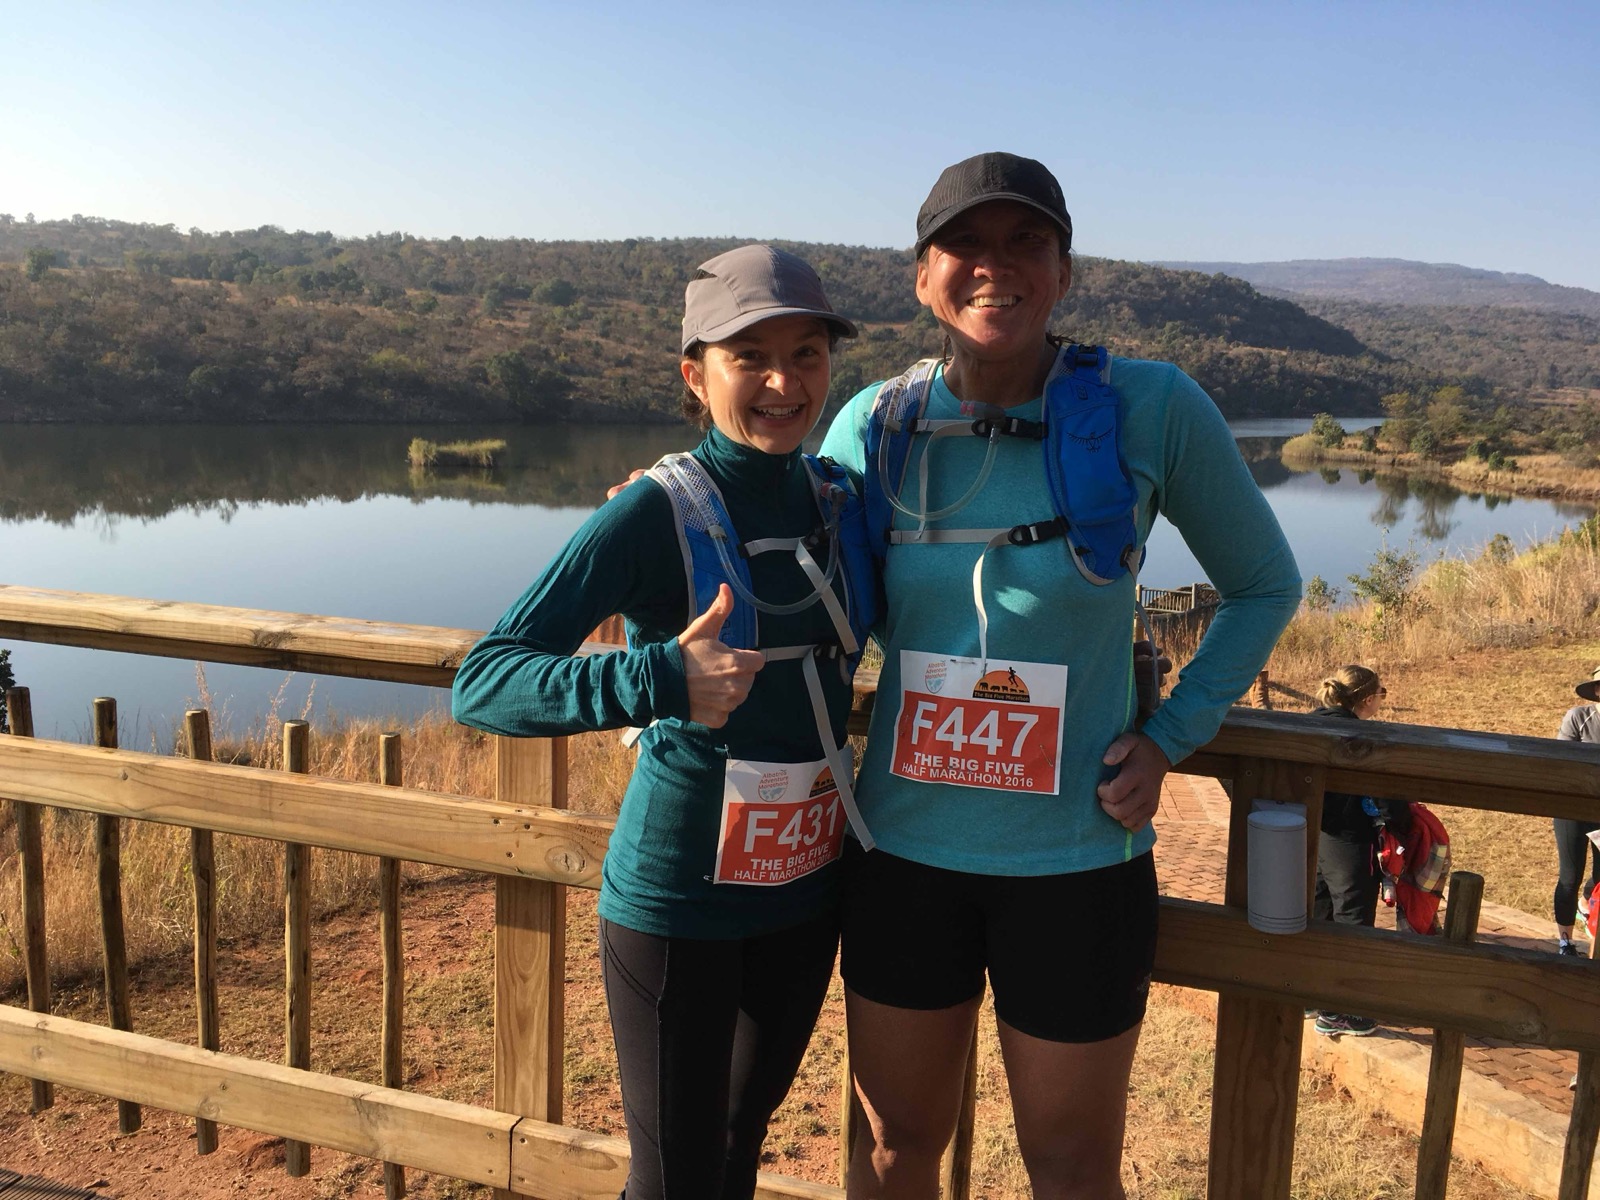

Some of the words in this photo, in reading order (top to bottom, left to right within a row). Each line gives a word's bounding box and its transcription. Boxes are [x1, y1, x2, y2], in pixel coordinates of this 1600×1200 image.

[1005, 694, 1029, 702] Marathon
[911, 700, 1039, 758] F447
[902, 762, 926, 777] HALF
[929, 769, 1002, 785] MARATHON
[1005, 776, 1034, 788] 2016
[914, 752, 943, 768] THE
[949, 756, 979, 772] BIG
[985, 761, 1025, 776] FIVE
[743, 795, 839, 853] F431
[734, 869, 766, 881] HALF
[769, 858, 817, 881] MARATHON
[750, 858, 783, 871] THE
[786, 852, 806, 869] BIG
[808, 842, 830, 860] FIVE
